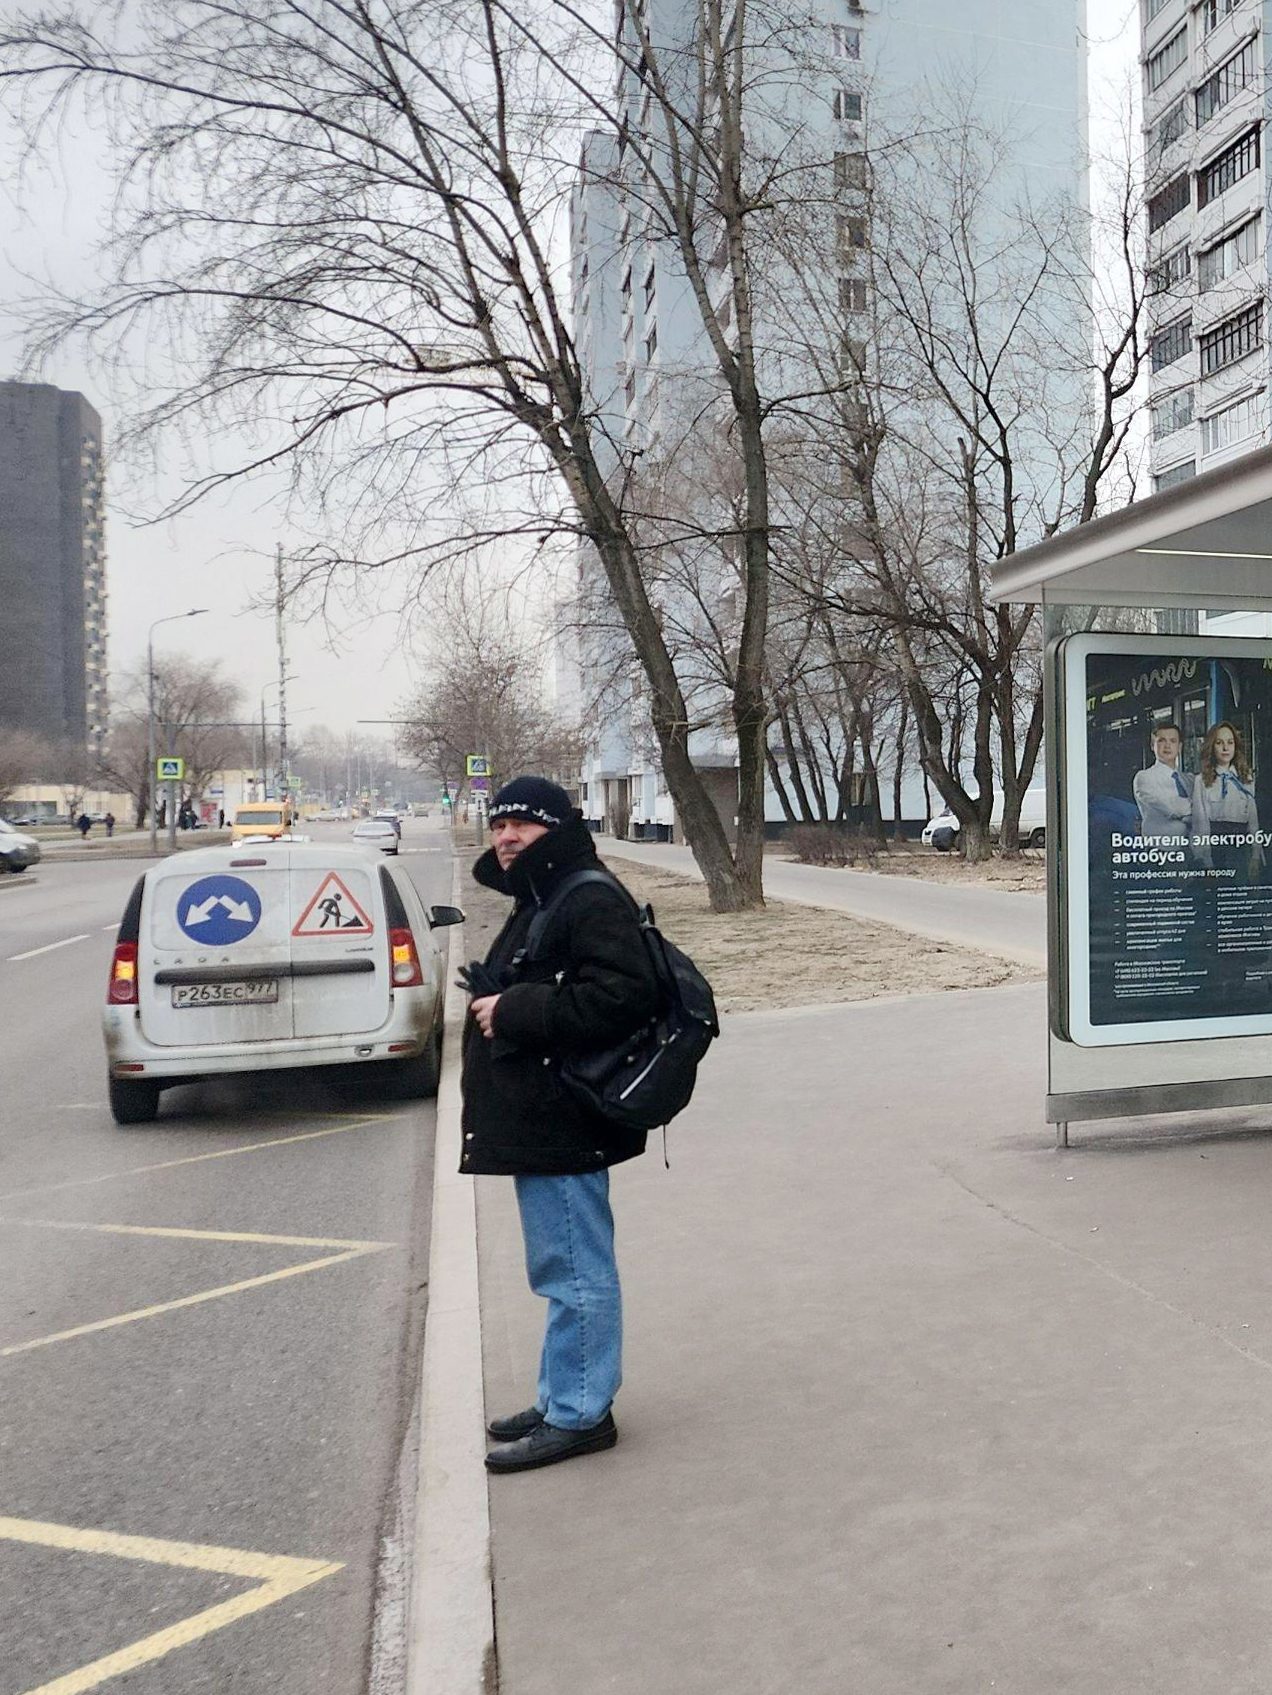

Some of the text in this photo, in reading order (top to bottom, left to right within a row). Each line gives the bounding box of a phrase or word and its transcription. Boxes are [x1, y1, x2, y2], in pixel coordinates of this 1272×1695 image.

[1111, 832, 1190, 849] Водитель
[1112, 848, 1185, 866] автобуса
[1112, 868, 1236, 880] Эта профессия нужна городу
